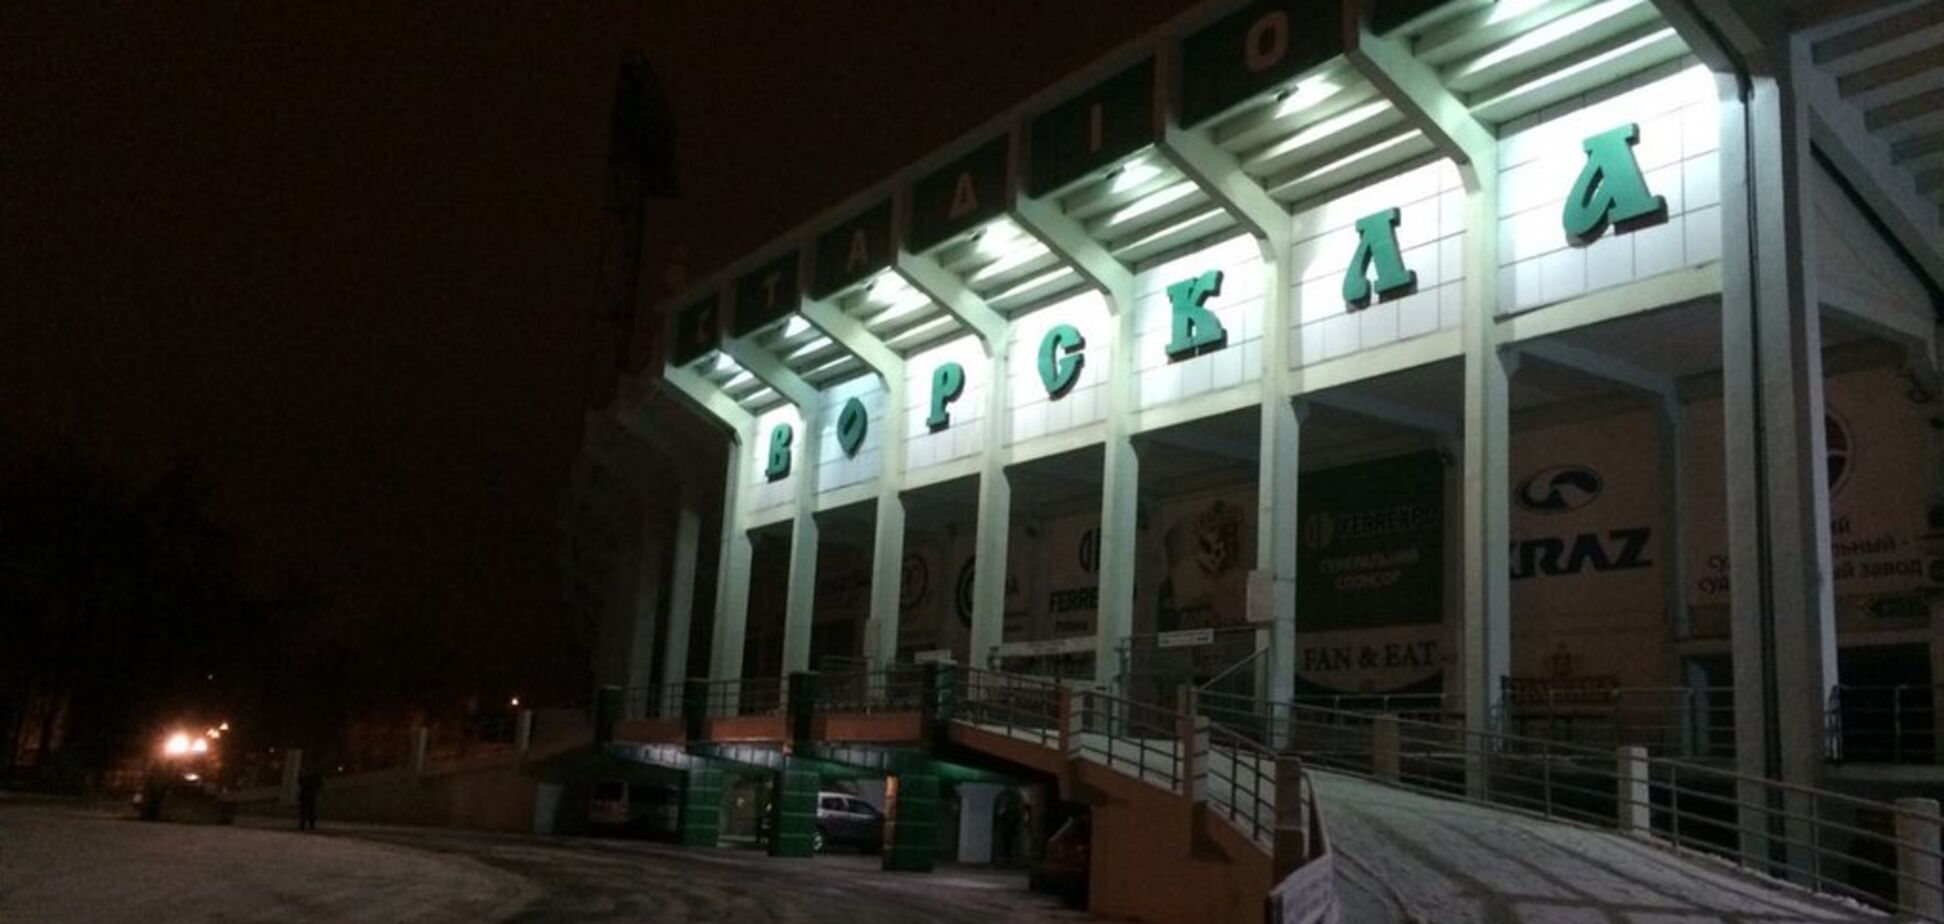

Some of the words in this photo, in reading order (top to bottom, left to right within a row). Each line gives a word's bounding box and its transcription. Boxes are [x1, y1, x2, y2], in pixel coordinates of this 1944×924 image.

[765, 122, 1668, 482] ВОРСКЛА
[1510, 526, 1653, 579] RAZ
[1303, 646, 1352, 671] FAN
[1358, 645, 1378, 669] &
[1384, 640, 1438, 668] EAT
